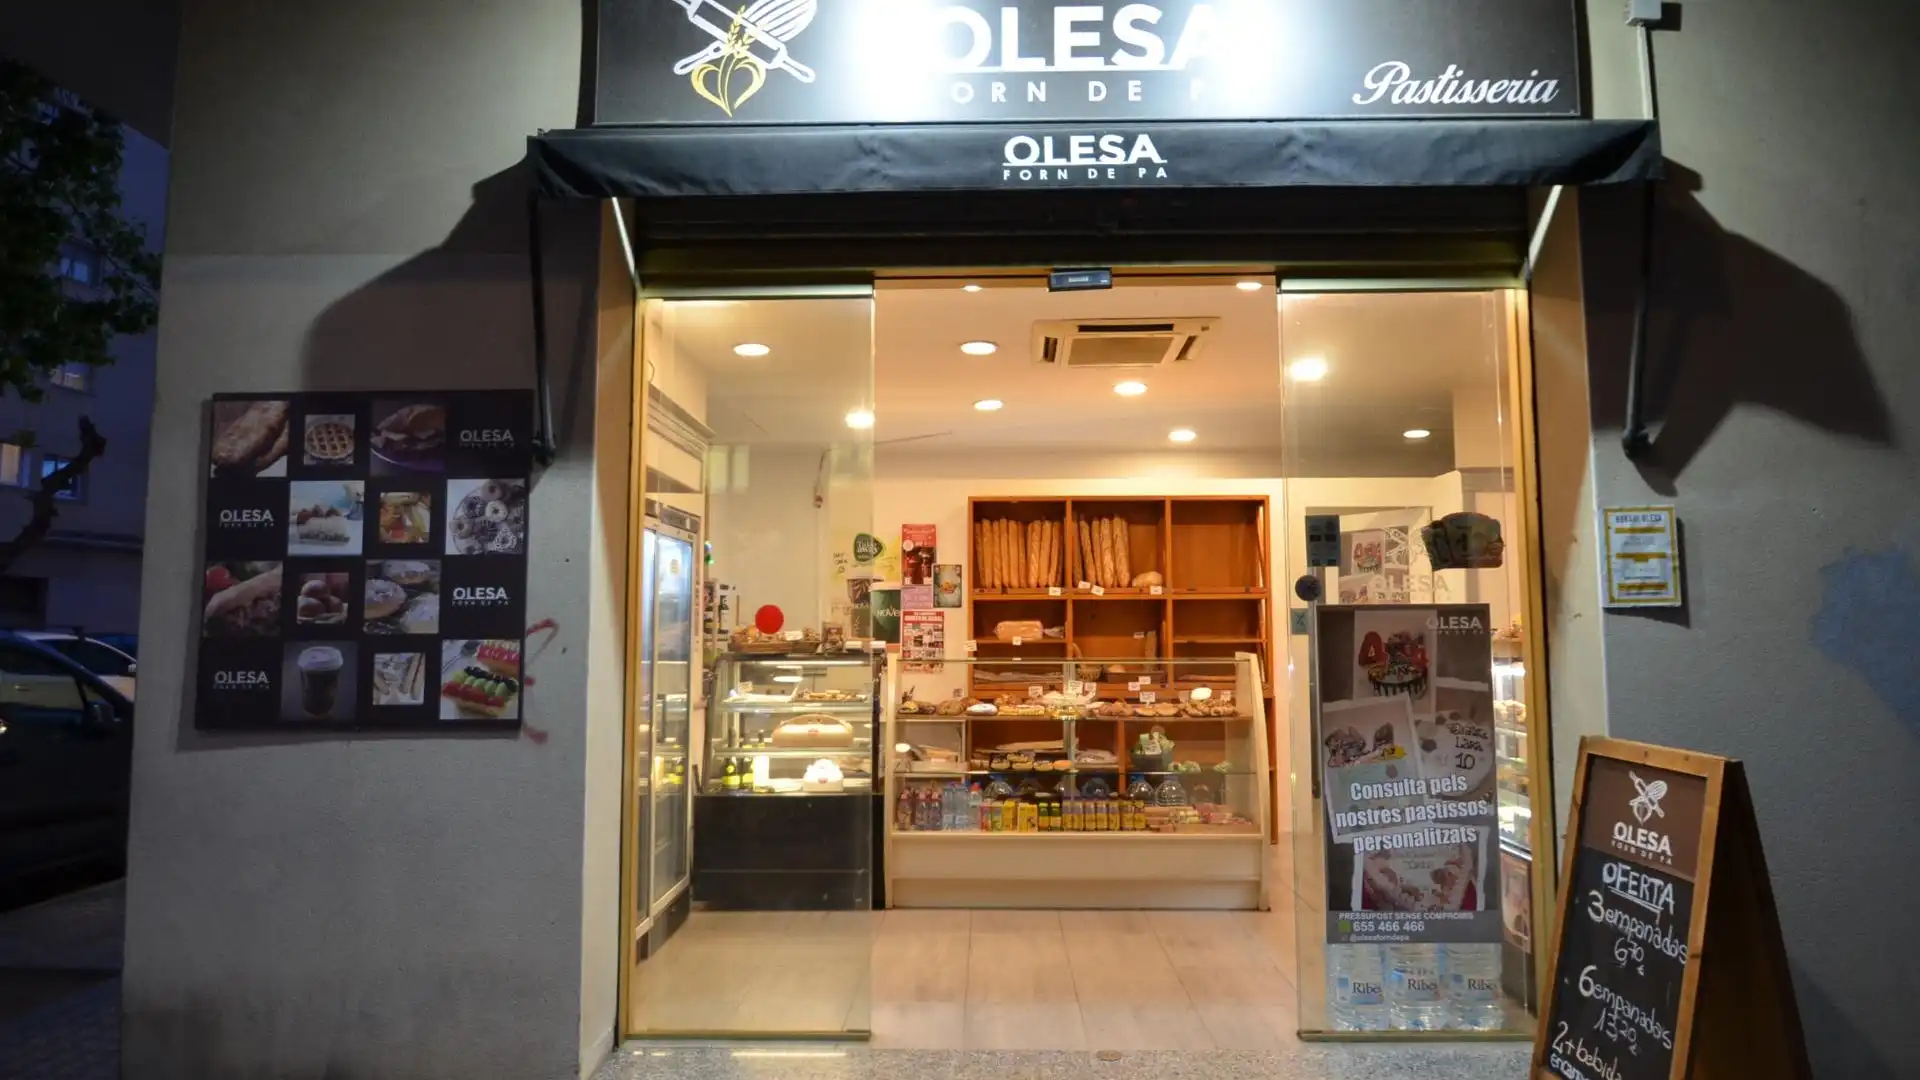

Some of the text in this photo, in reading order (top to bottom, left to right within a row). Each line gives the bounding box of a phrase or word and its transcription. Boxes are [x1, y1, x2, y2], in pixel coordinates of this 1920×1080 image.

[952, 79, 1143, 103] ORN DE
[1352, 60, 1560, 105] Pastisseria
[1003, 133, 1165, 165] OLESA
[1003, 166, 1168, 181] FORN DE PA
[460, 428, 514, 442] OLESA
[220, 509, 274, 522] OLESA
[452, 586, 508, 600] OLESA
[215, 670, 269, 684] OLESA
[1455, 751, 1476, 770] 10
[1350, 774, 1468, 800] Consulta pels
[1336, 800, 1489, 828] nostres pastissos
[1353, 827, 1478, 854] personalitzats
[1612, 821, 1673, 857] OLESA
[1602, 862, 1676, 915] OFERTA
[1338, 911, 1393, 920] PRESSUPOST
[1394, 911, 1422, 920] SENSE
[1353, 921, 1425, 932] 655 466 466
